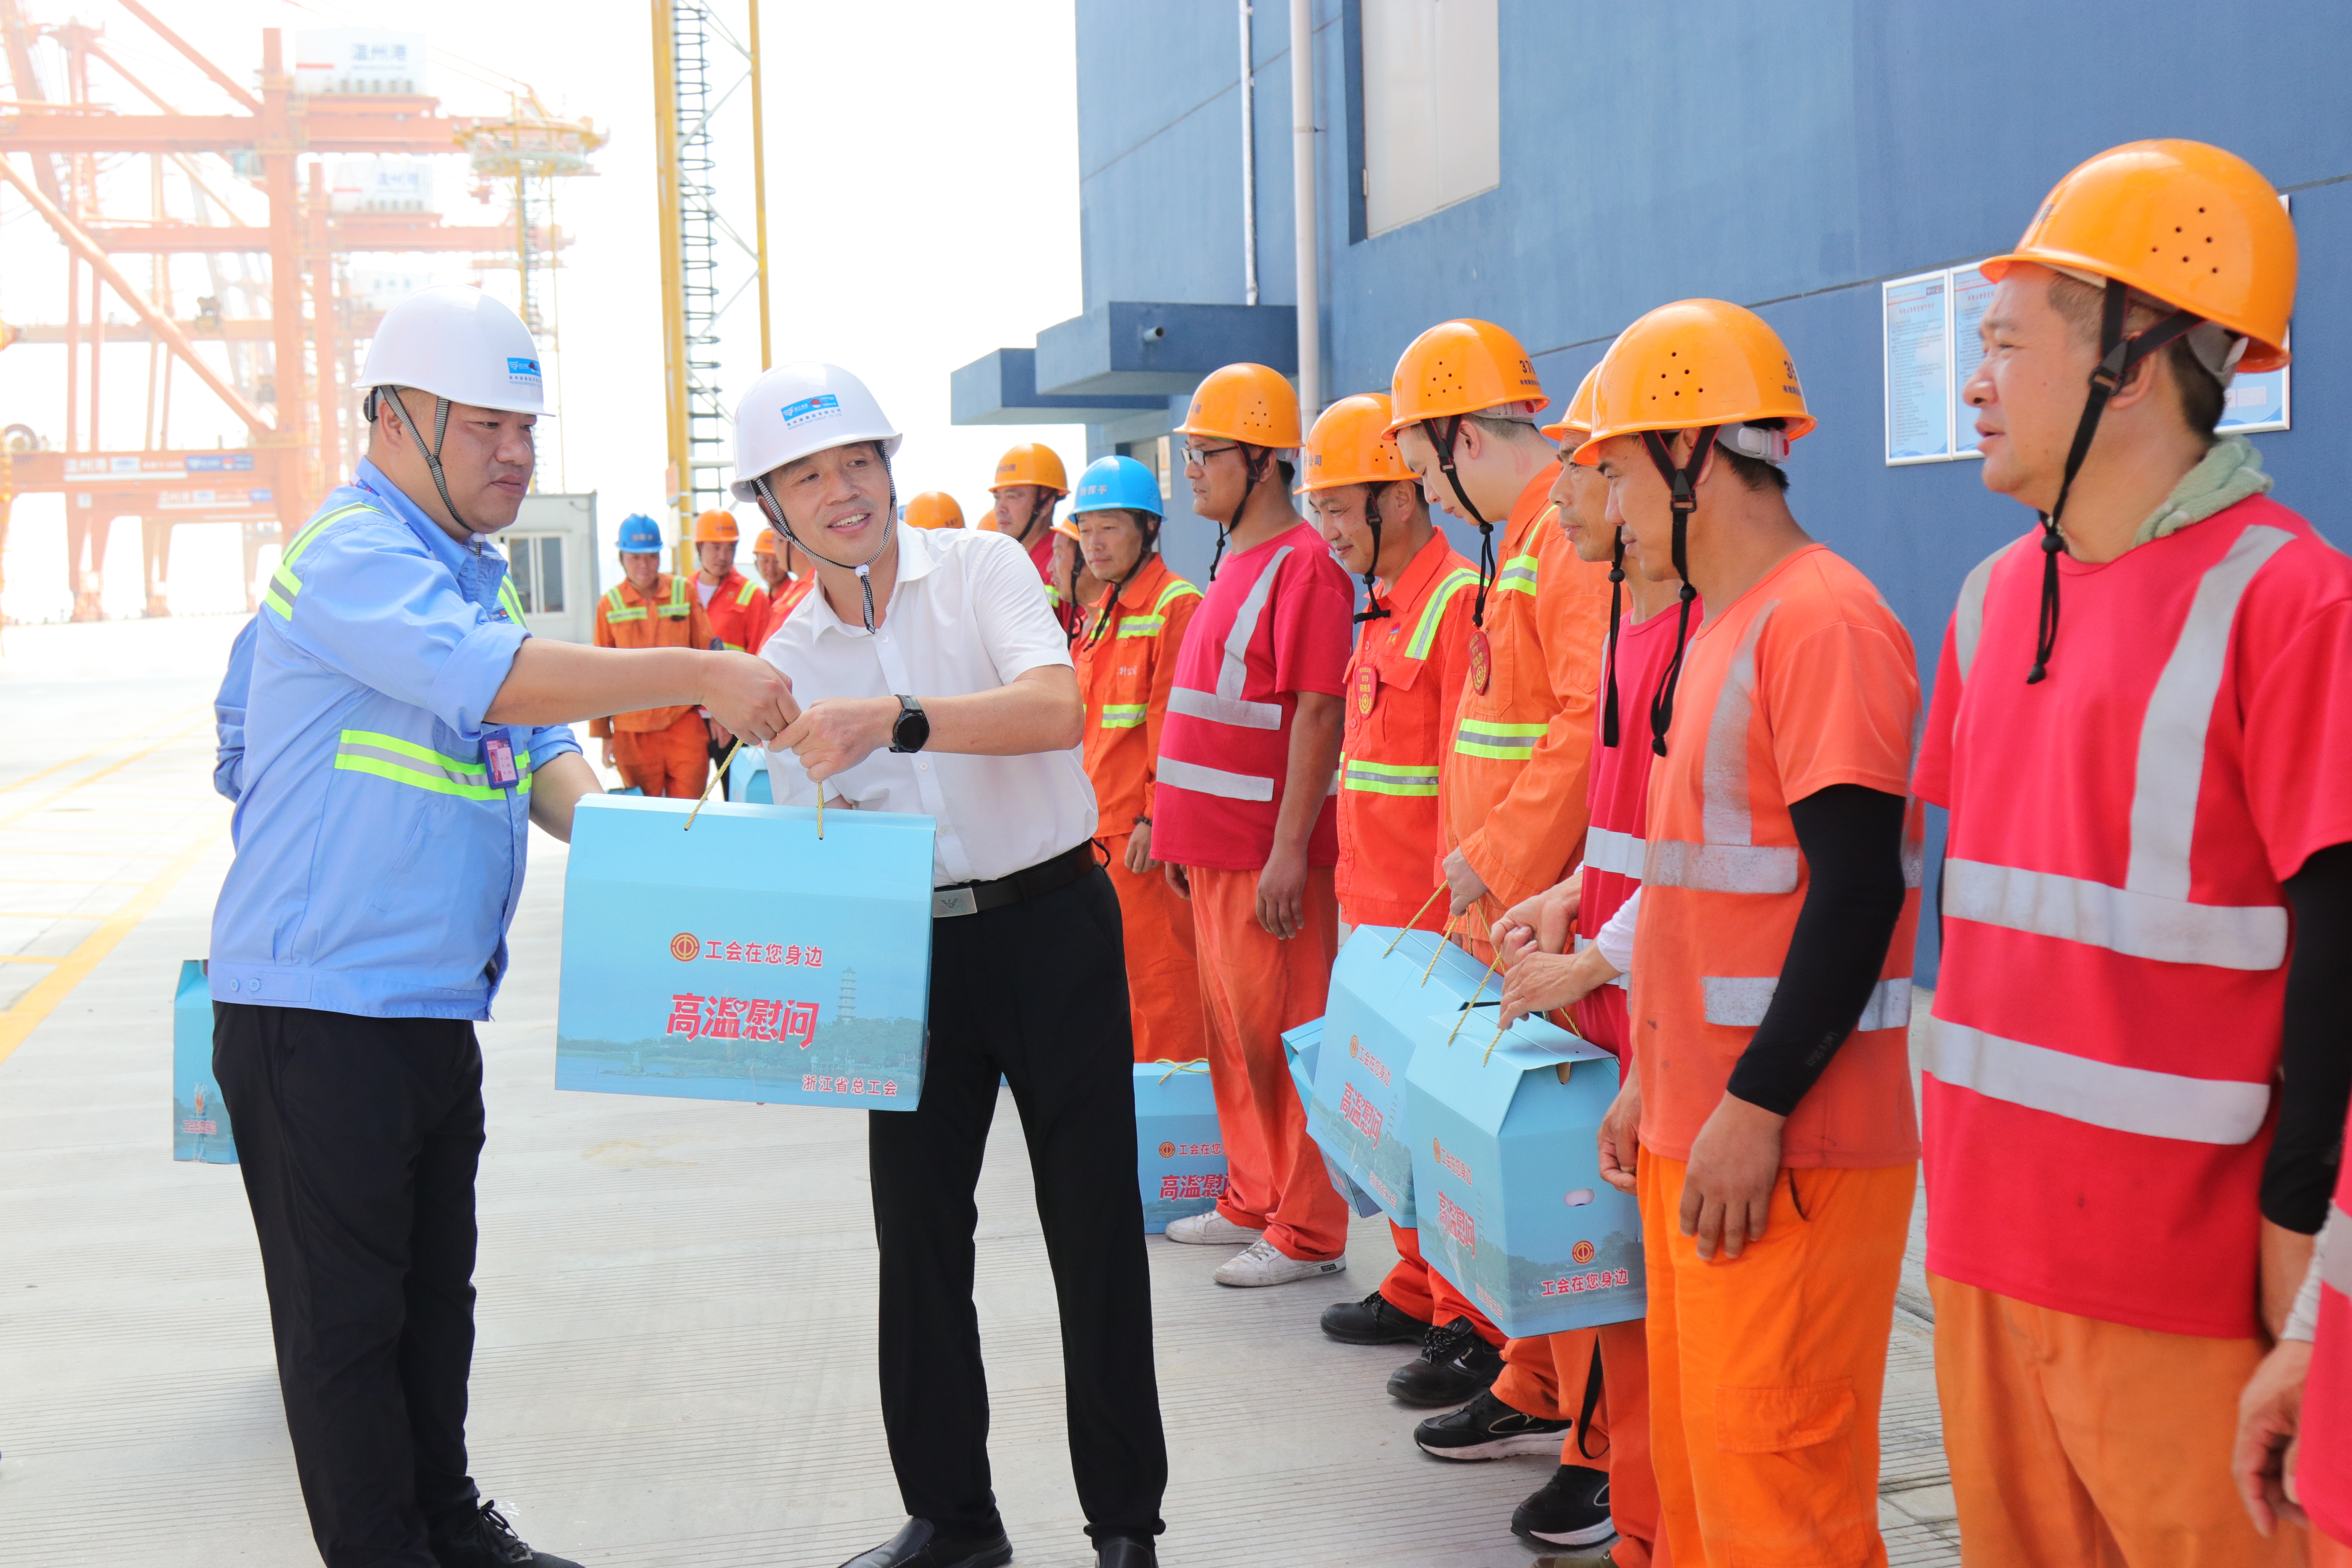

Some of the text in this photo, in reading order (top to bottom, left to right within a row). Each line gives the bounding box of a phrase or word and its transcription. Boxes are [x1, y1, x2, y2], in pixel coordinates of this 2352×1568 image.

[1359, 684, 1372, 692] 网格员
[705, 940, 823, 968] 工会在您身边
[1358, 1045, 1392, 1088] 工会在您身边
[802, 1074, 898, 1096] 浙江省总工会
[1178, 1142, 1225, 1156] 工会在您
[1441, 1147, 1473, 1187] 工会在您身边
[1369, 1170, 1398, 1210] 浙江省总工会
[1541, 1268, 1629, 1297] 工会在您身边
